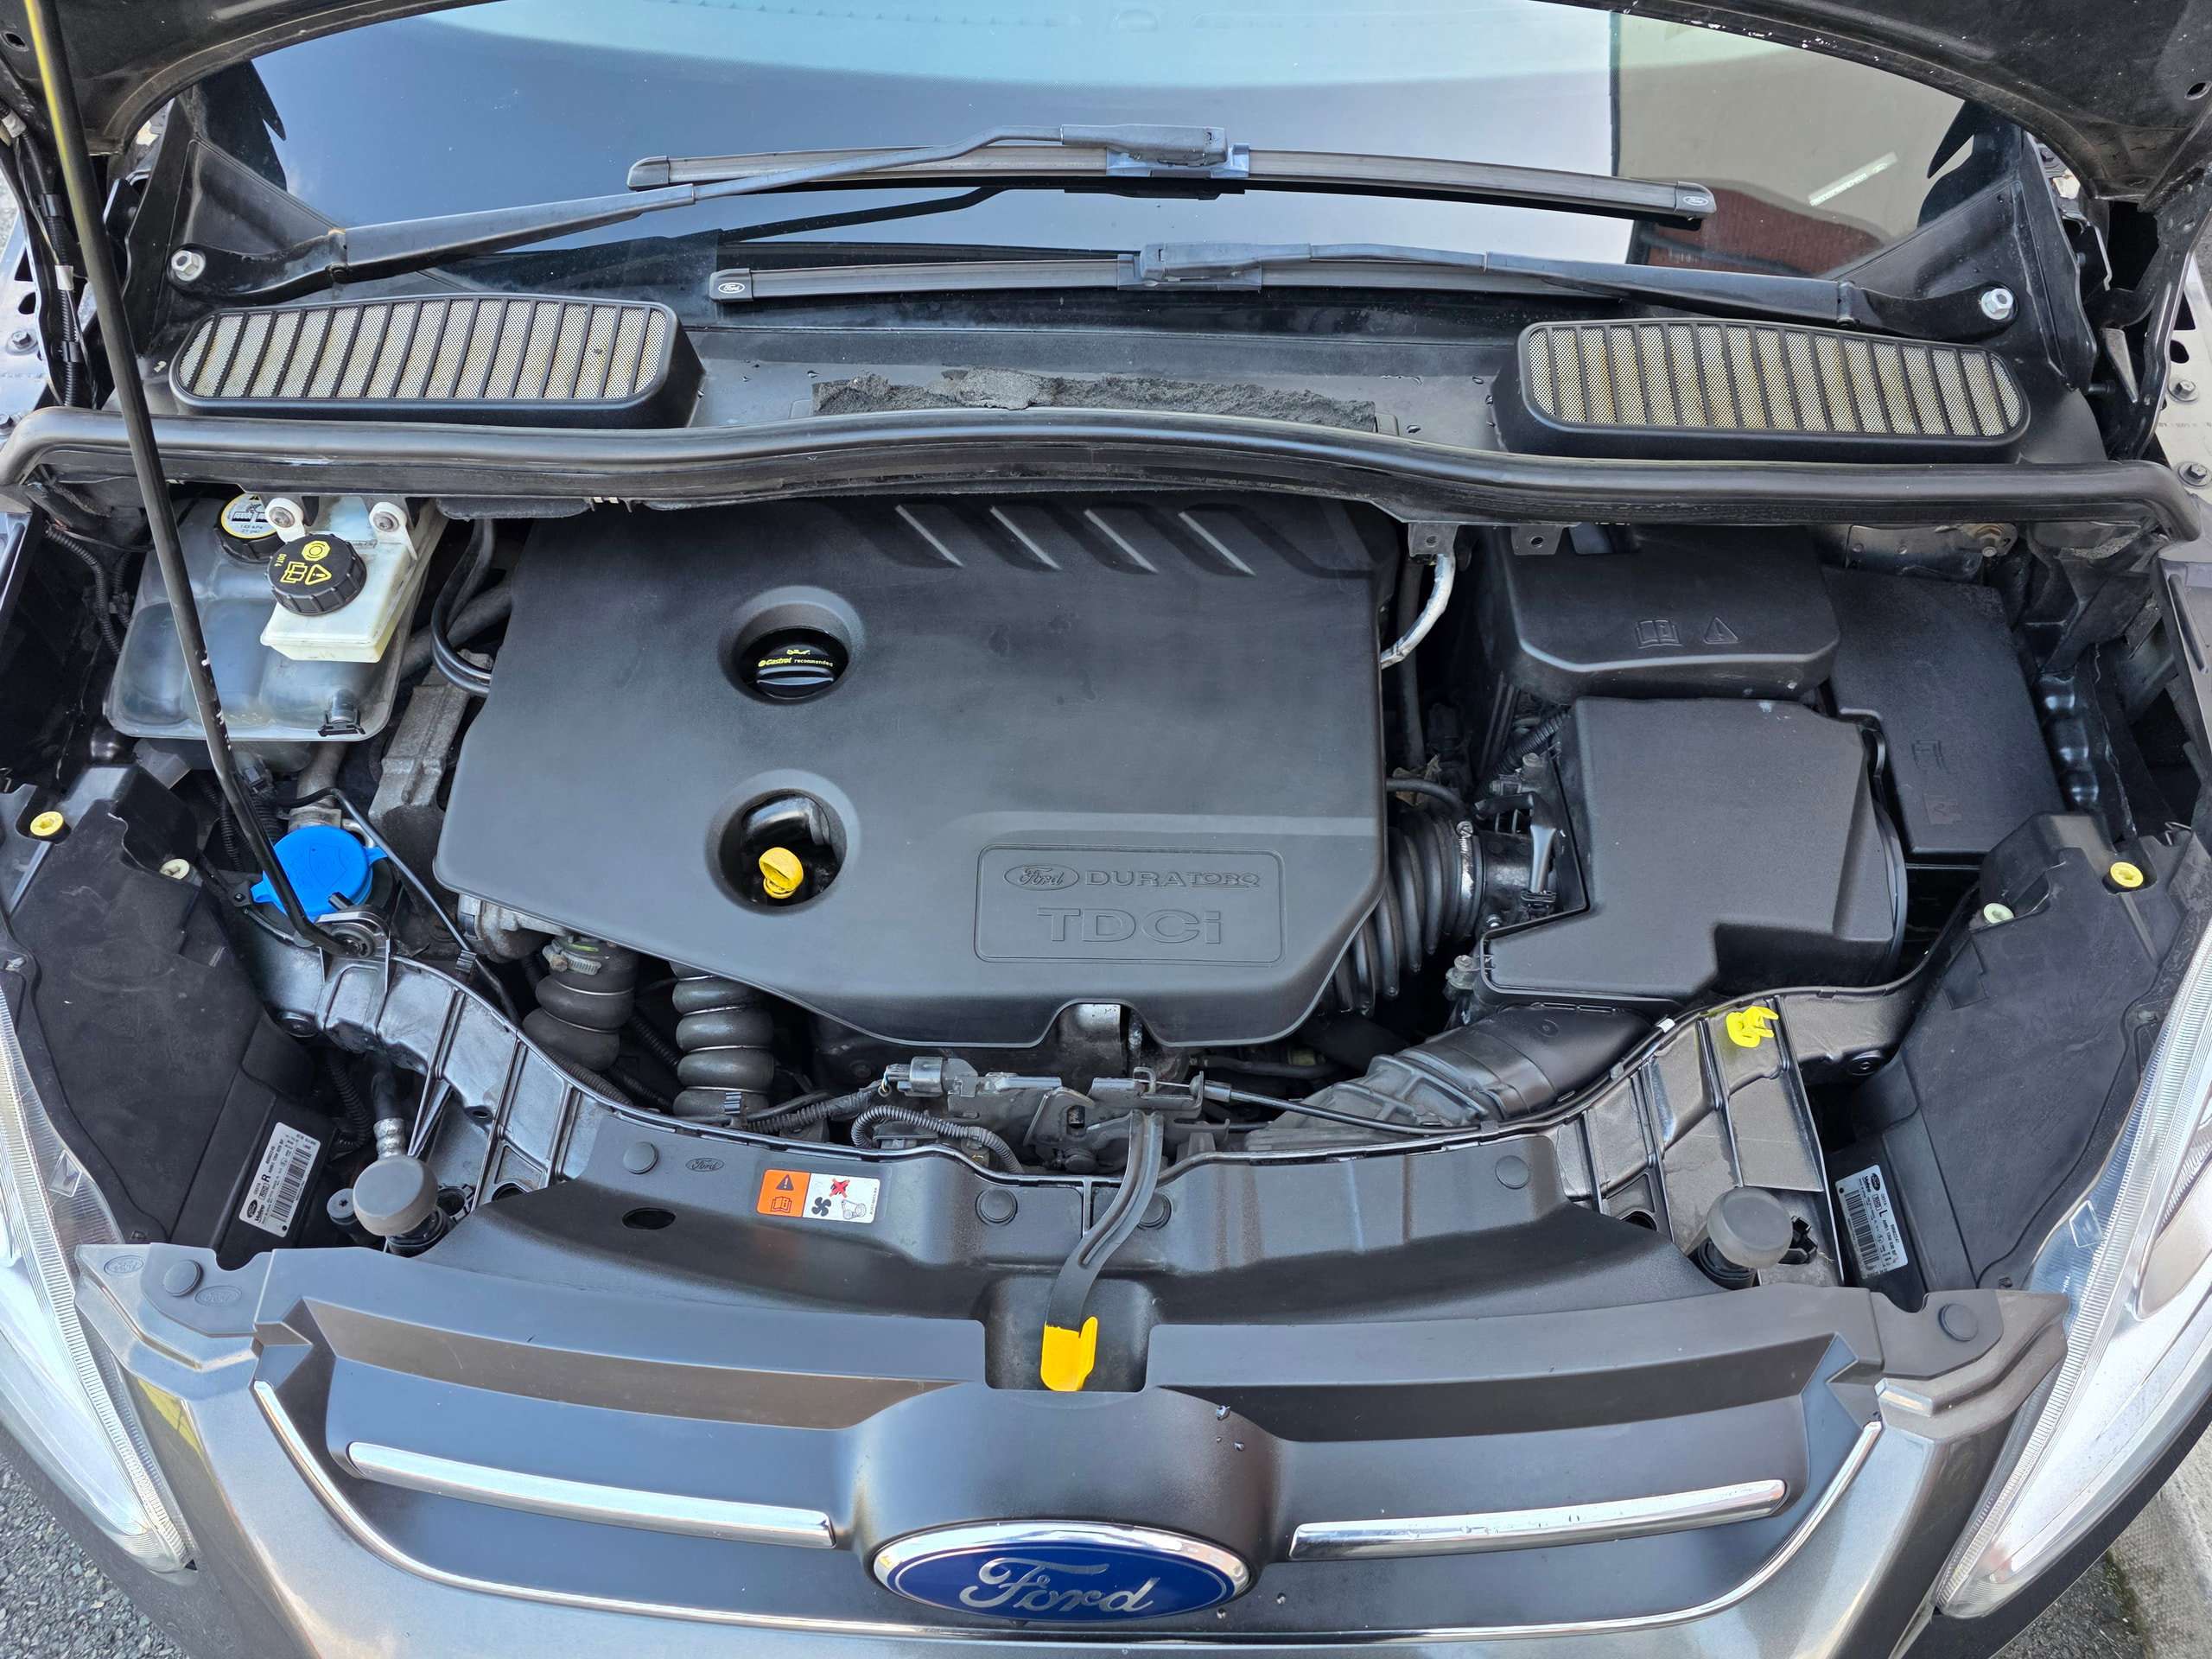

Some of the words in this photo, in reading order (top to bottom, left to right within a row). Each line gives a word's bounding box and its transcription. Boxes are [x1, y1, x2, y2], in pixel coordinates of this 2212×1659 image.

[1019, 865, 1065, 887] Ford
[1084, 870, 1261, 887] DURATORQ
[1037, 908, 1222, 944] TDCi
[691, 1158, 719, 1171] Ford
[262, 1173, 270, 1182] R
[958, 1557, 1160, 1613] Ford
